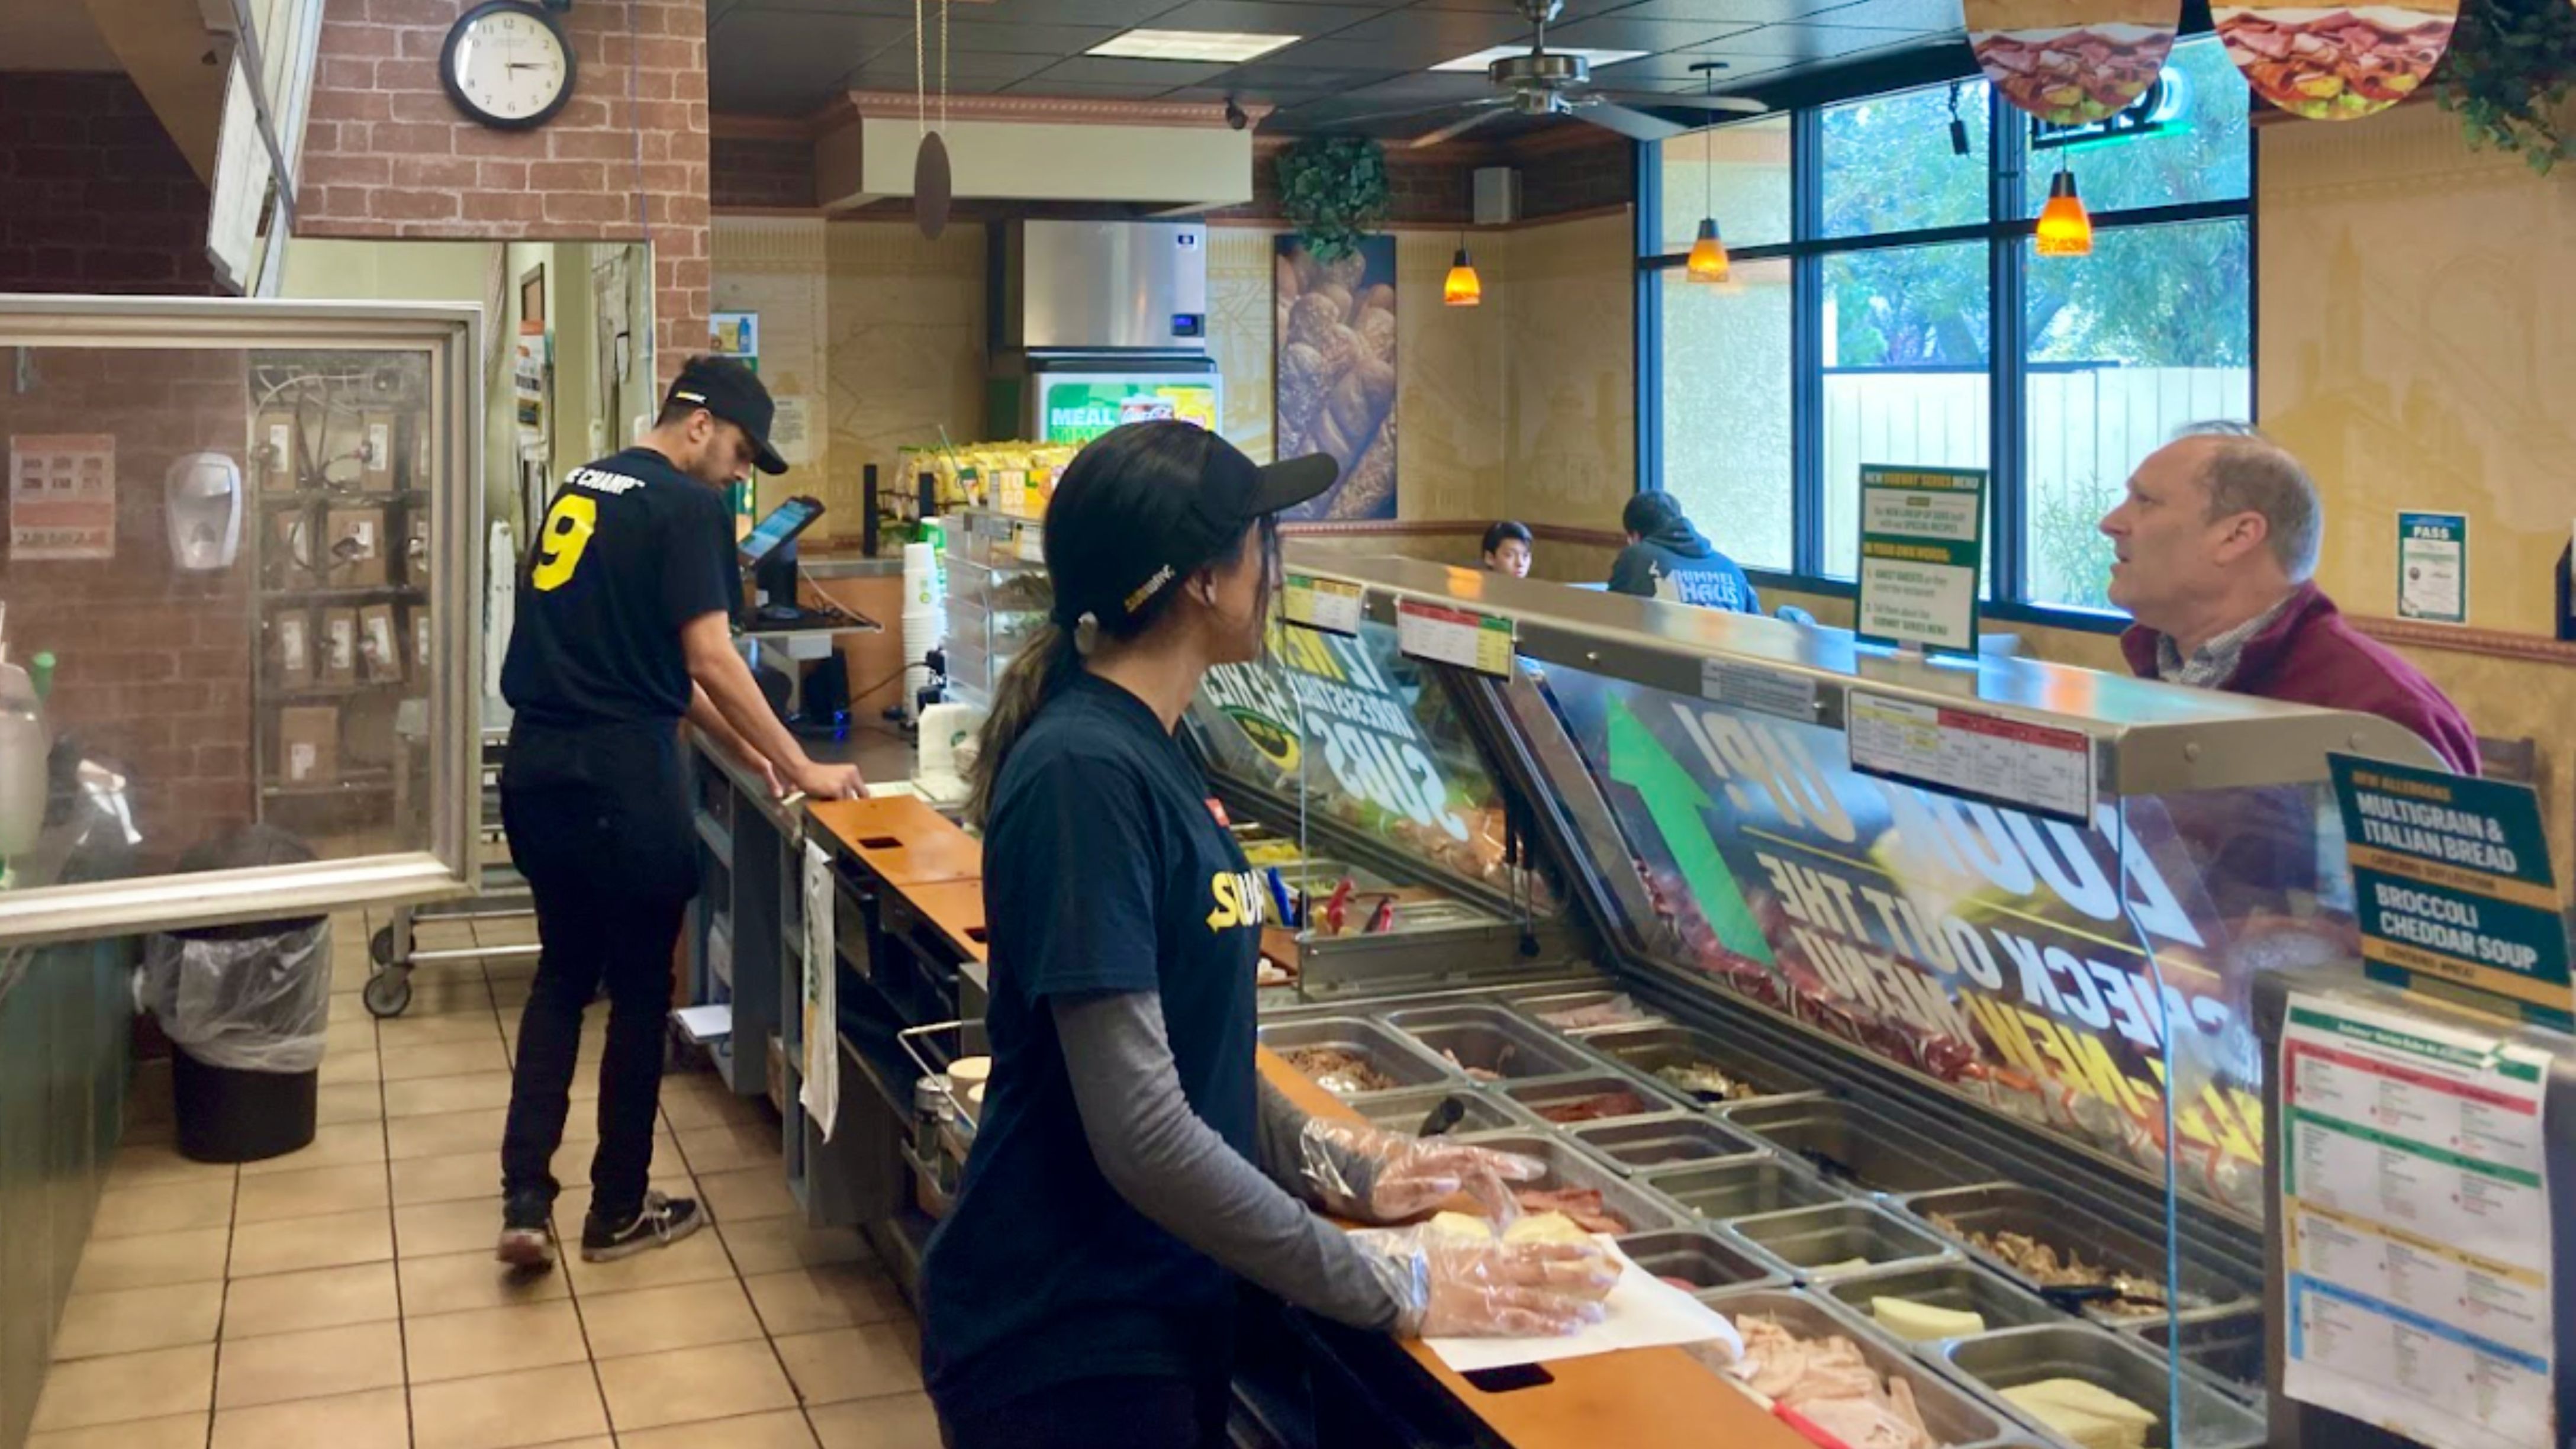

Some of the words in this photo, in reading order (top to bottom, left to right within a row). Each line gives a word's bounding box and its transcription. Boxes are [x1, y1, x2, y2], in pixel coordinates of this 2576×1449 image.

[1052, 408, 1115, 426] MEAL
[533, 493, 596, 591] 9
[2413, 526, 2449, 540] PASS
[1677, 570, 1735, 585] HIMMEL
[1681, 582, 1738, 604] HAUS
[2356, 792, 2483, 838] MULTIGRAIN
[2485, 817, 2505, 843] &
[2362, 818, 2442, 857] ITALIAN
[2444, 836, 2517, 873] BREAD
[2375, 882, 2479, 930] BROCCOLI
[2379, 911, 2477, 957] CHEDDAR
[2478, 935, 2539, 971] SOUP
